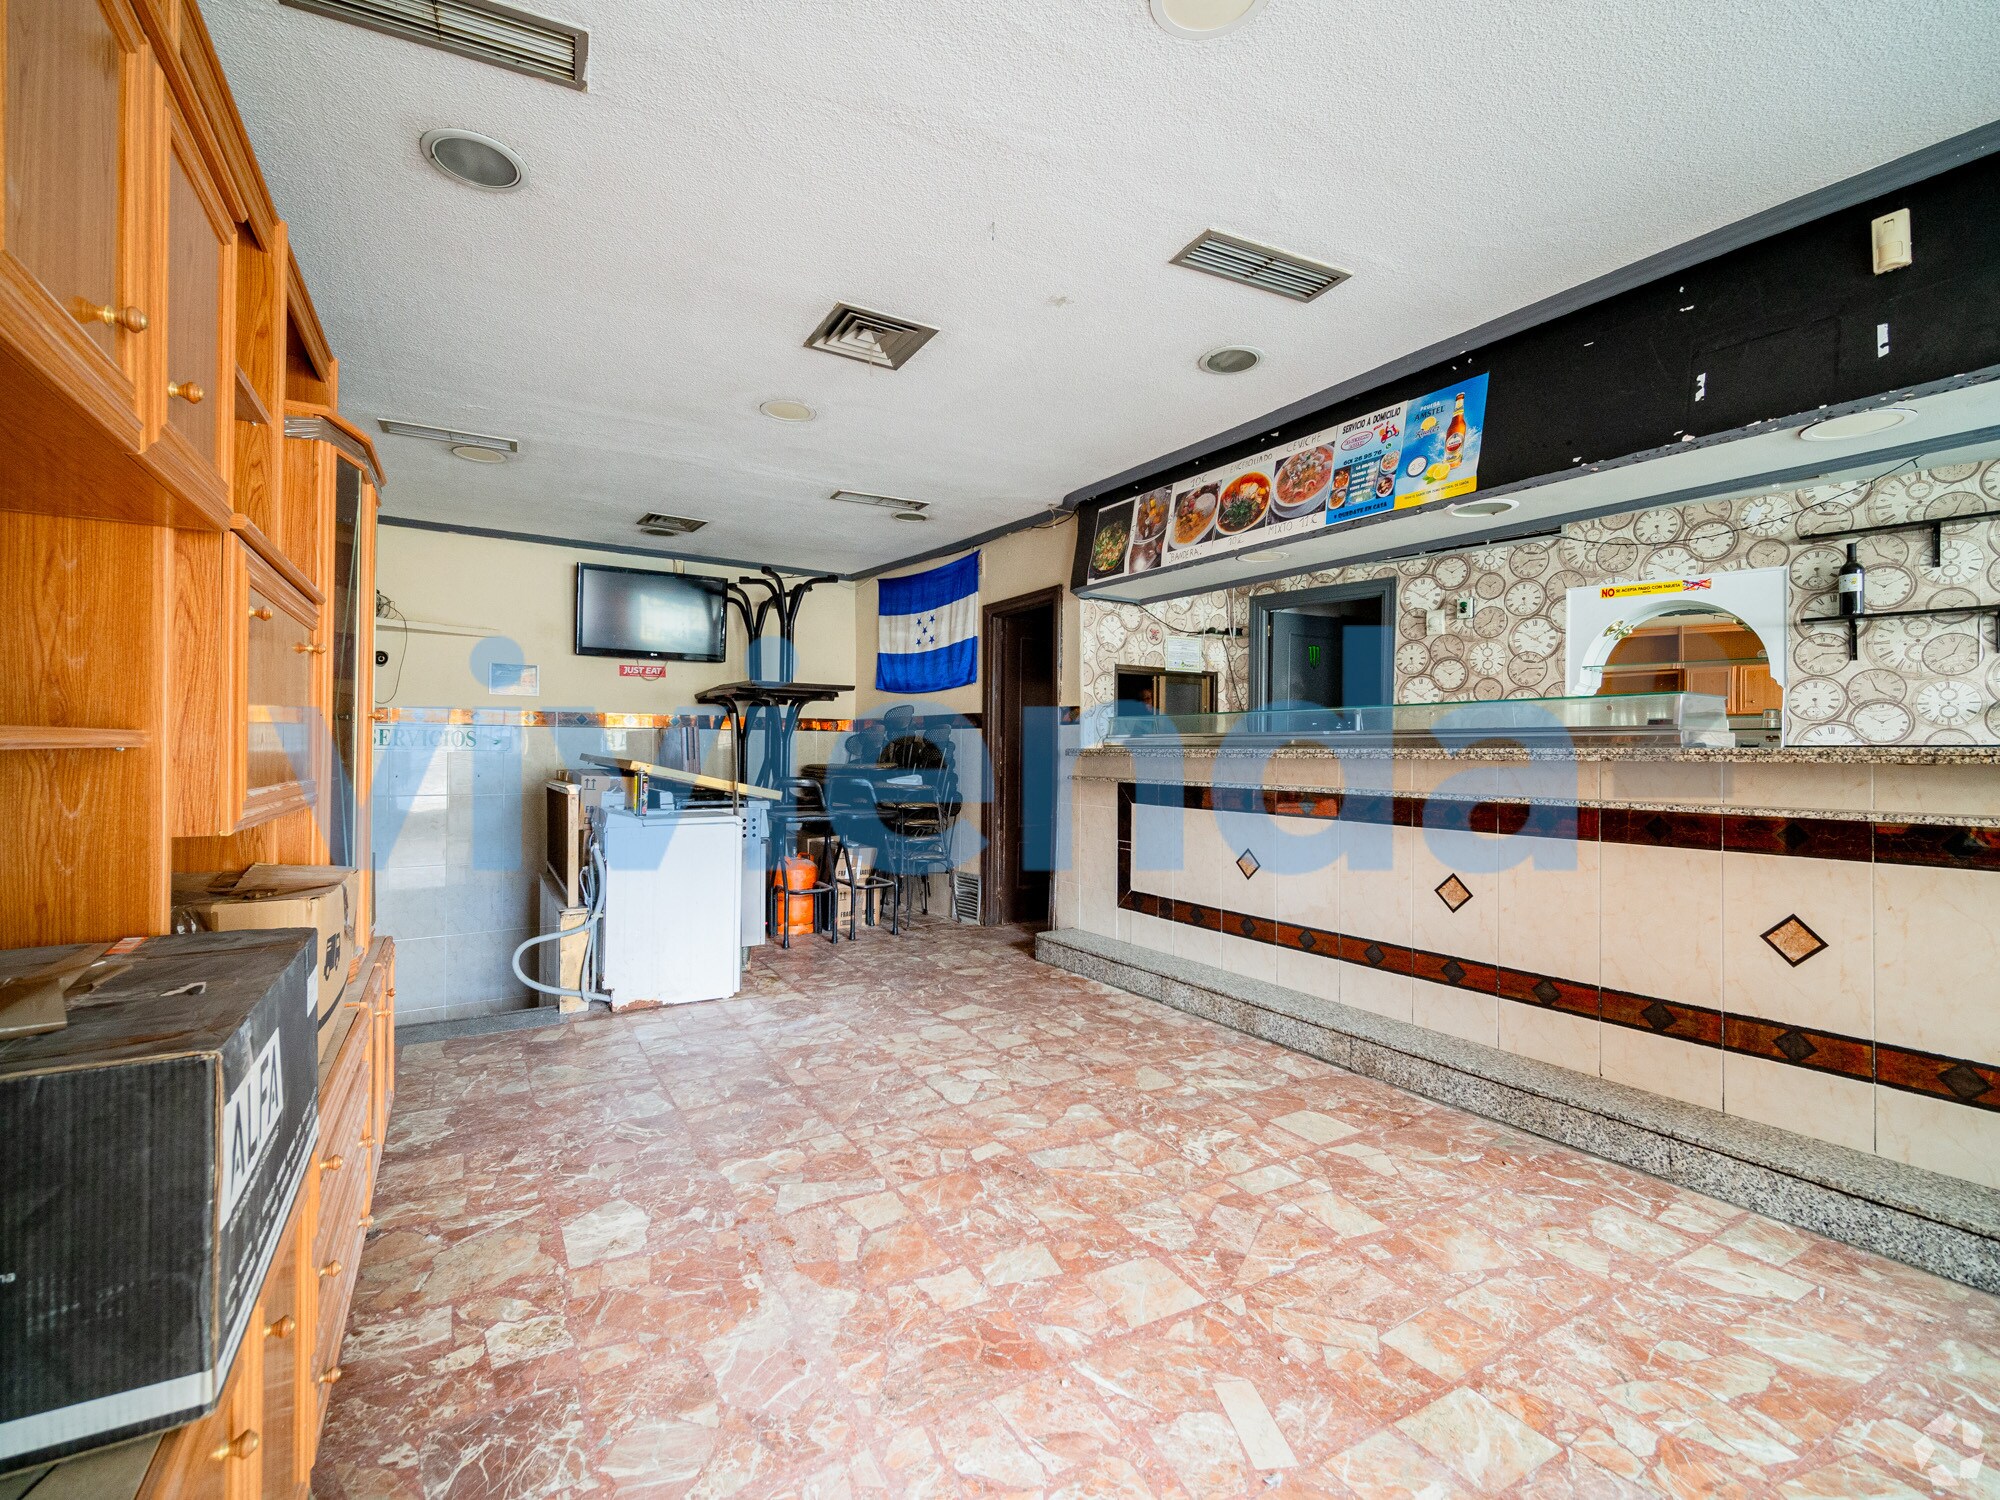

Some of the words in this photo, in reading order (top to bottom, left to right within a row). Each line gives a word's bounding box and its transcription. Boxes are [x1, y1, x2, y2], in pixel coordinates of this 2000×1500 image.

[1414, 406, 1444, 421] AMSTEL
[1342, 419, 1366, 434] SERVICIO
[1367, 417, 1371, 426] A
[1286, 433, 1321, 453] CEVICHE
[1268, 521, 1293, 536] MIXTO
[1601, 588, 1615, 598] NO
[623, 666, 644, 674] JUST
[645, 667, 662, 675] EAT
[373, 728, 477, 748] ERVICIOS
[230, 1043, 279, 1200] ALFA
